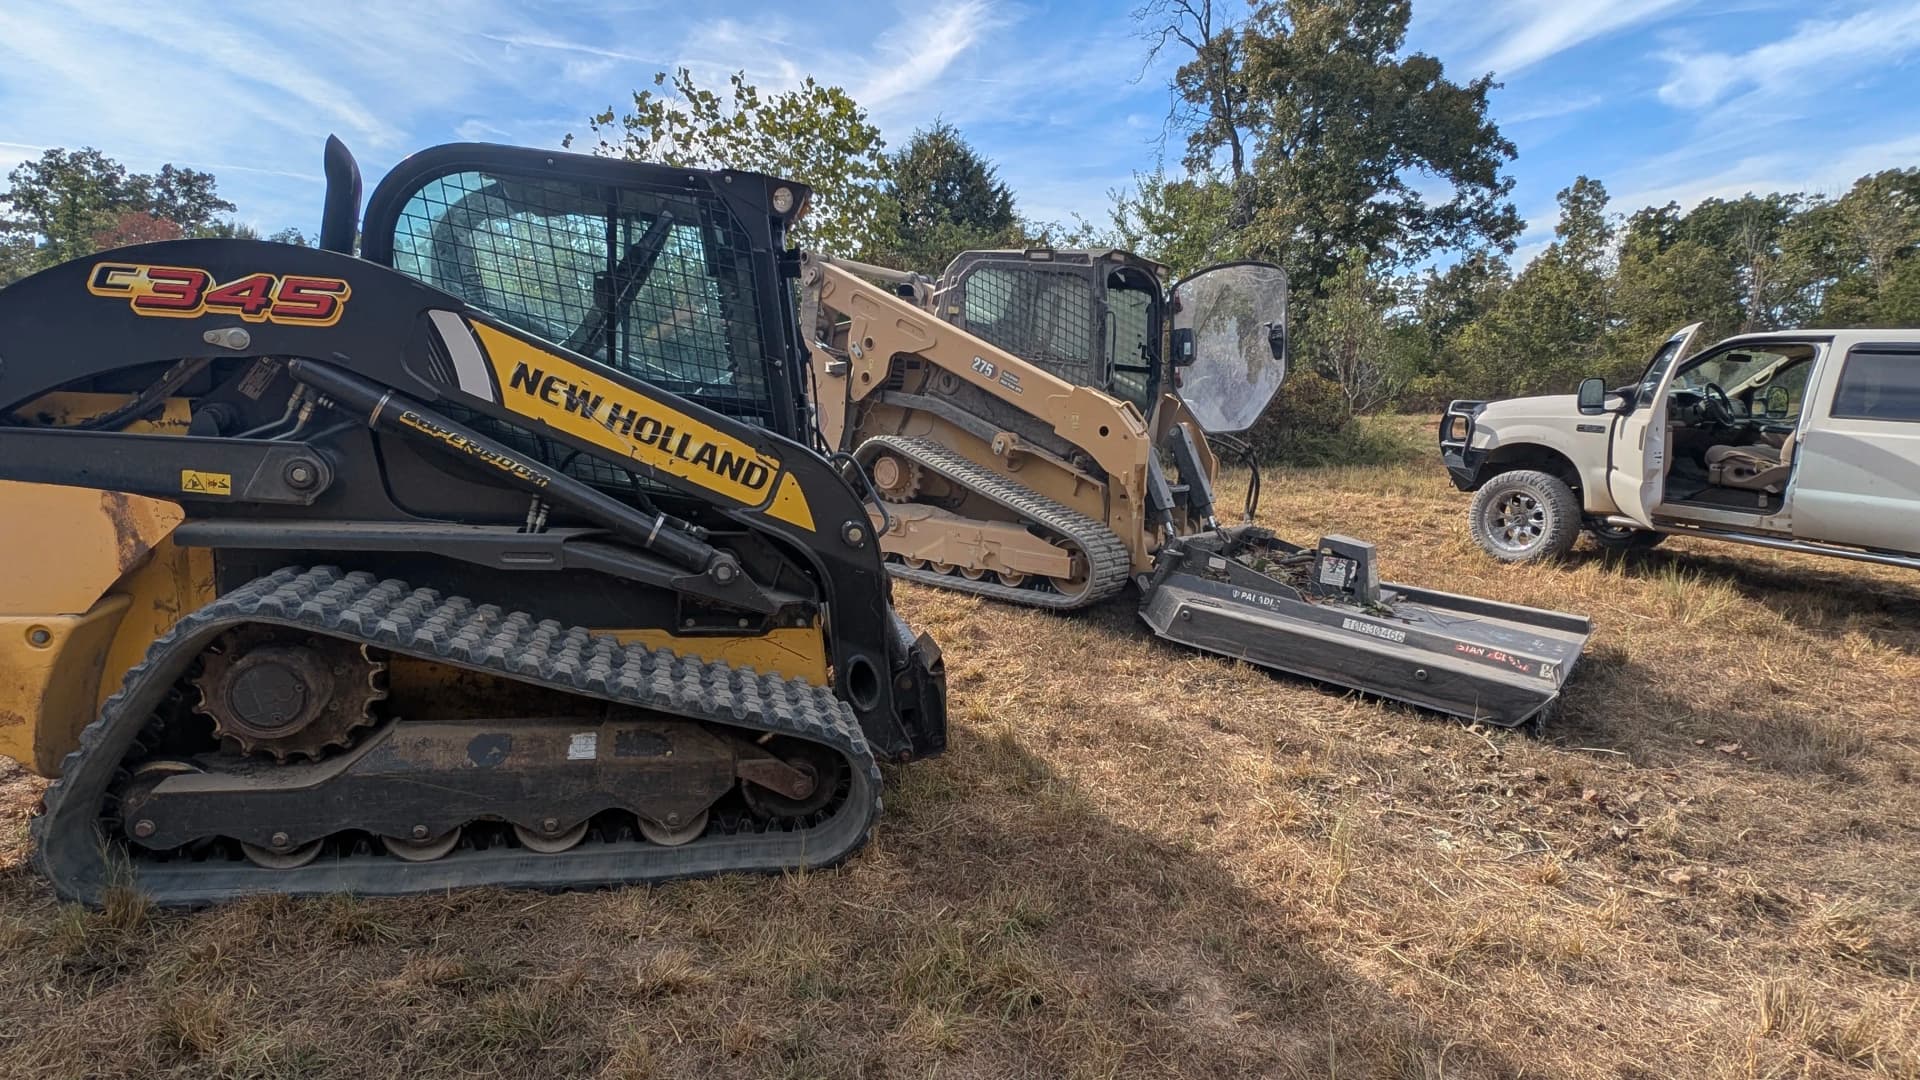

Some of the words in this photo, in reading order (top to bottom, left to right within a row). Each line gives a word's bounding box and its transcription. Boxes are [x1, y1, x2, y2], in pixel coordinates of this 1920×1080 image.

[89, 262, 351, 323] C345
[972, 356, 994, 377] 275
[510, 361, 603, 419] NEW
[605, 402, 770, 490] HOLLAND
